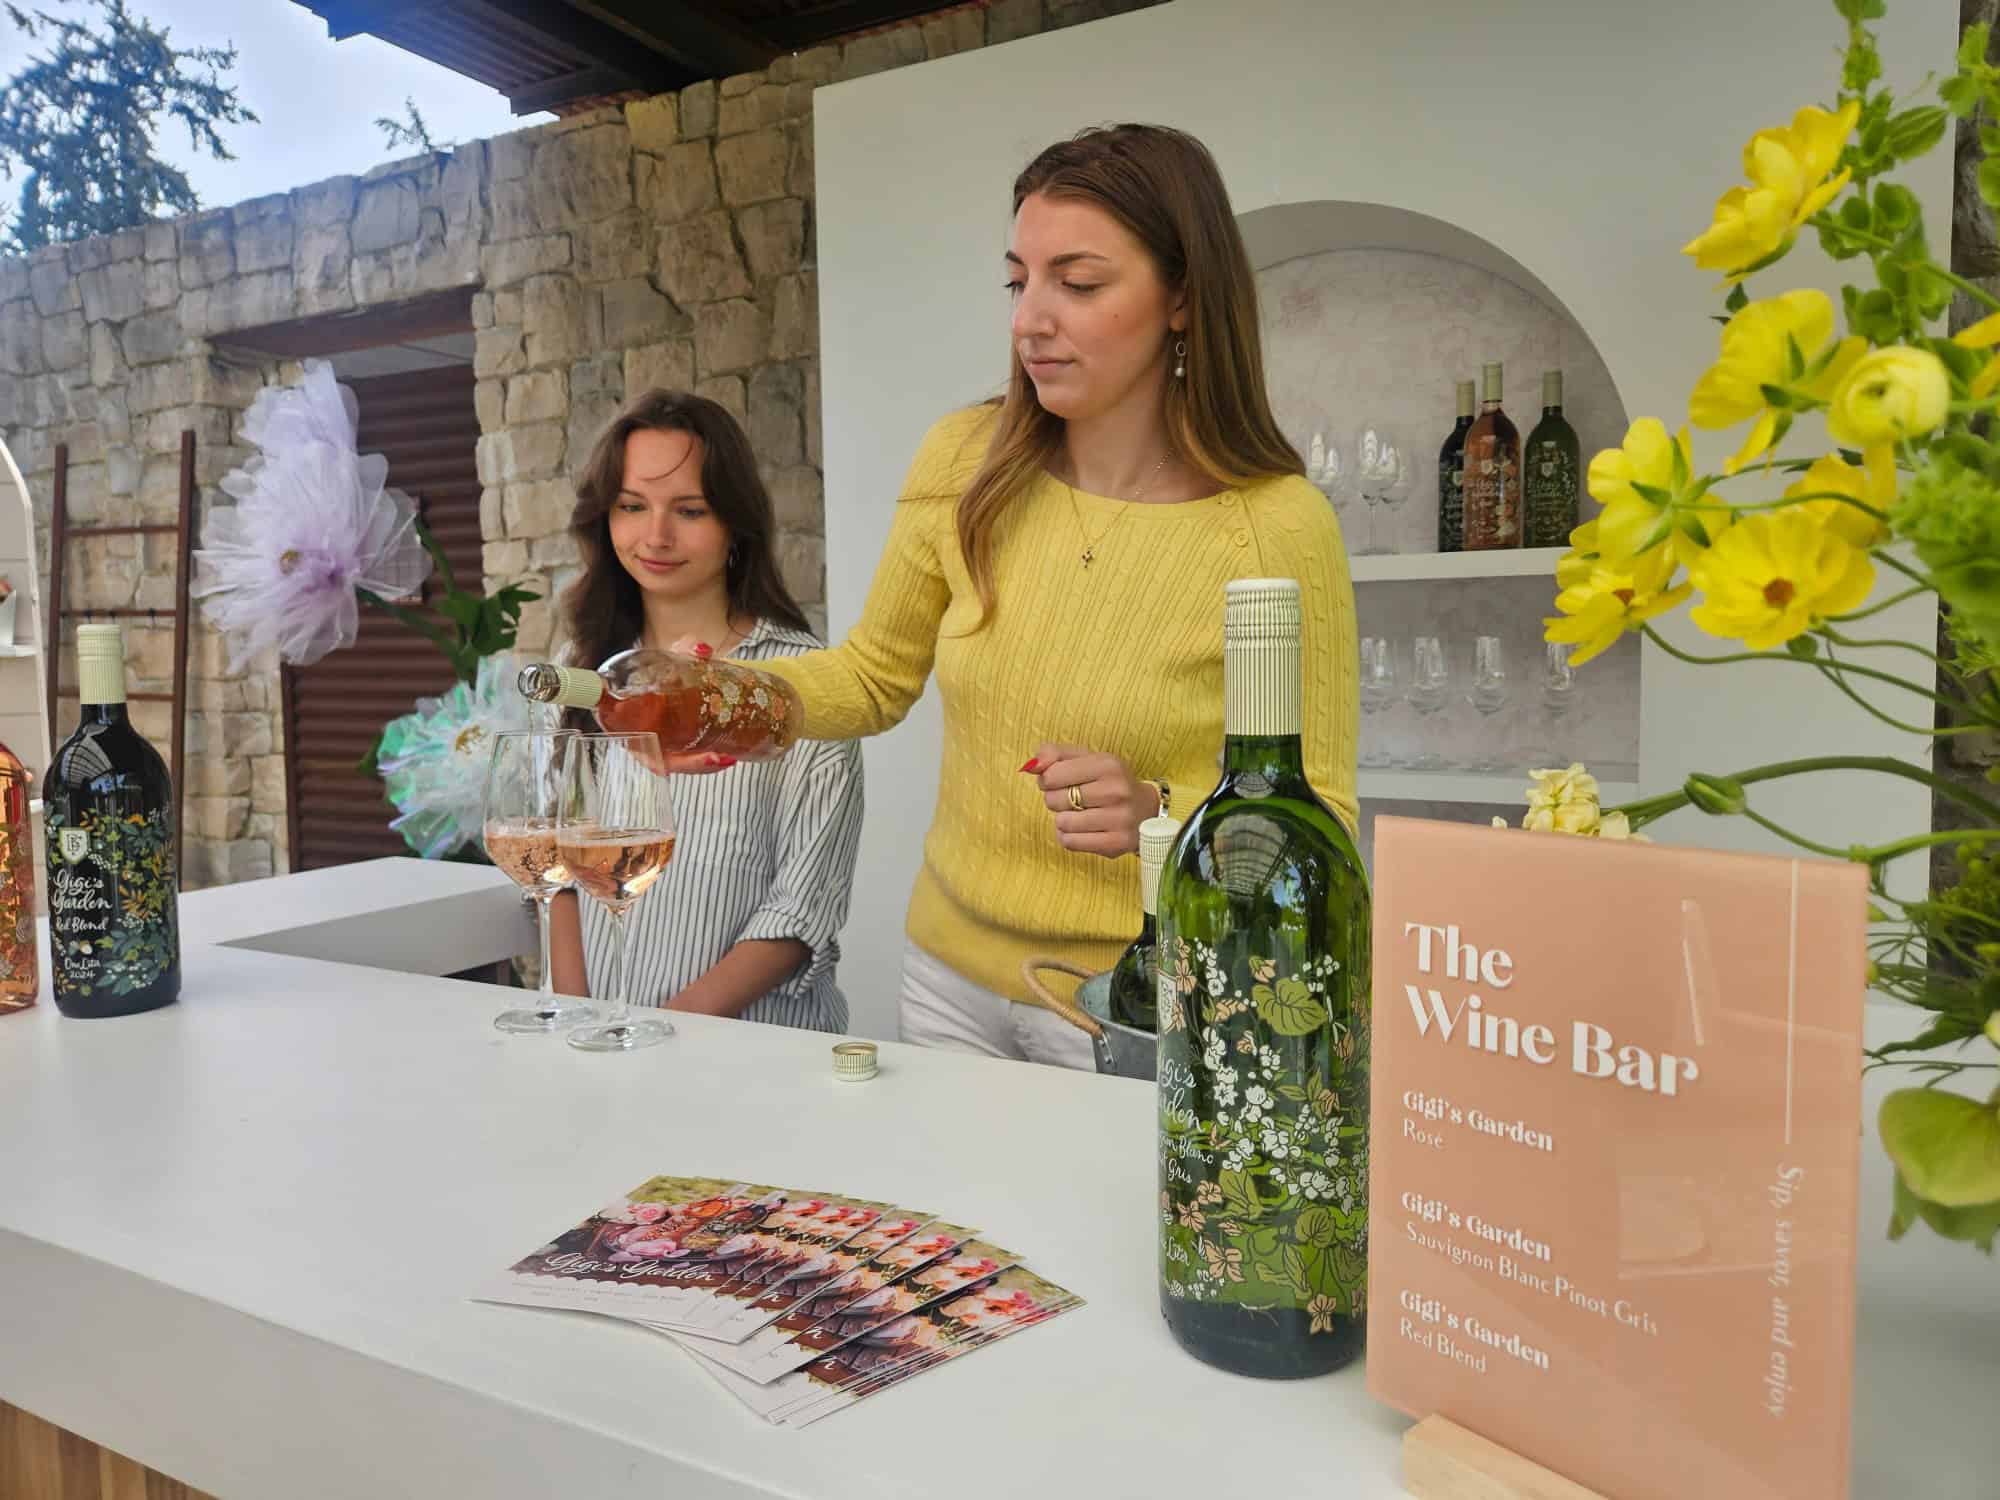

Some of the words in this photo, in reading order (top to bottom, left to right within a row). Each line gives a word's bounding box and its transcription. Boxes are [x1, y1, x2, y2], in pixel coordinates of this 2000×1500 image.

[52, 889, 113, 914] Garden
[54, 868, 104, 895] Gigi's
[72, 916, 109, 933] Blend
[1404, 922, 1513, 988] The
[1404, 984, 1555, 1064] Wine
[1573, 1021, 1699, 1097] Bar
[1160, 1056, 1197, 1090] gi's
[1403, 1090, 1463, 1124] Gigi's
[1467, 1109, 1553, 1152] Garden
[1167, 1158, 1193, 1184] Gris
[1401, 1191, 1461, 1229] Gigi's
[1466, 1215, 1551, 1261] Garden
[543, 1252, 617, 1275] Gigi's
[619, 1258, 715, 1282] Garden
[1407, 1221, 1494, 1273] Sauvignon
[1499, 1255, 1550, 1293] Blanc
[1555, 1275, 1608, 1317] Pinot
[1614, 1300, 1658, 1337] Gris
[1400, 1289, 1459, 1329] Gigi's
[1464, 1316, 1549, 1370] Garden
[1400, 1317, 1432, 1349] Red
[1437, 1333, 1487, 1374] Blend
[1770, 1297, 1797, 1348] and
[1762, 1351, 1795, 1417] enjoy
